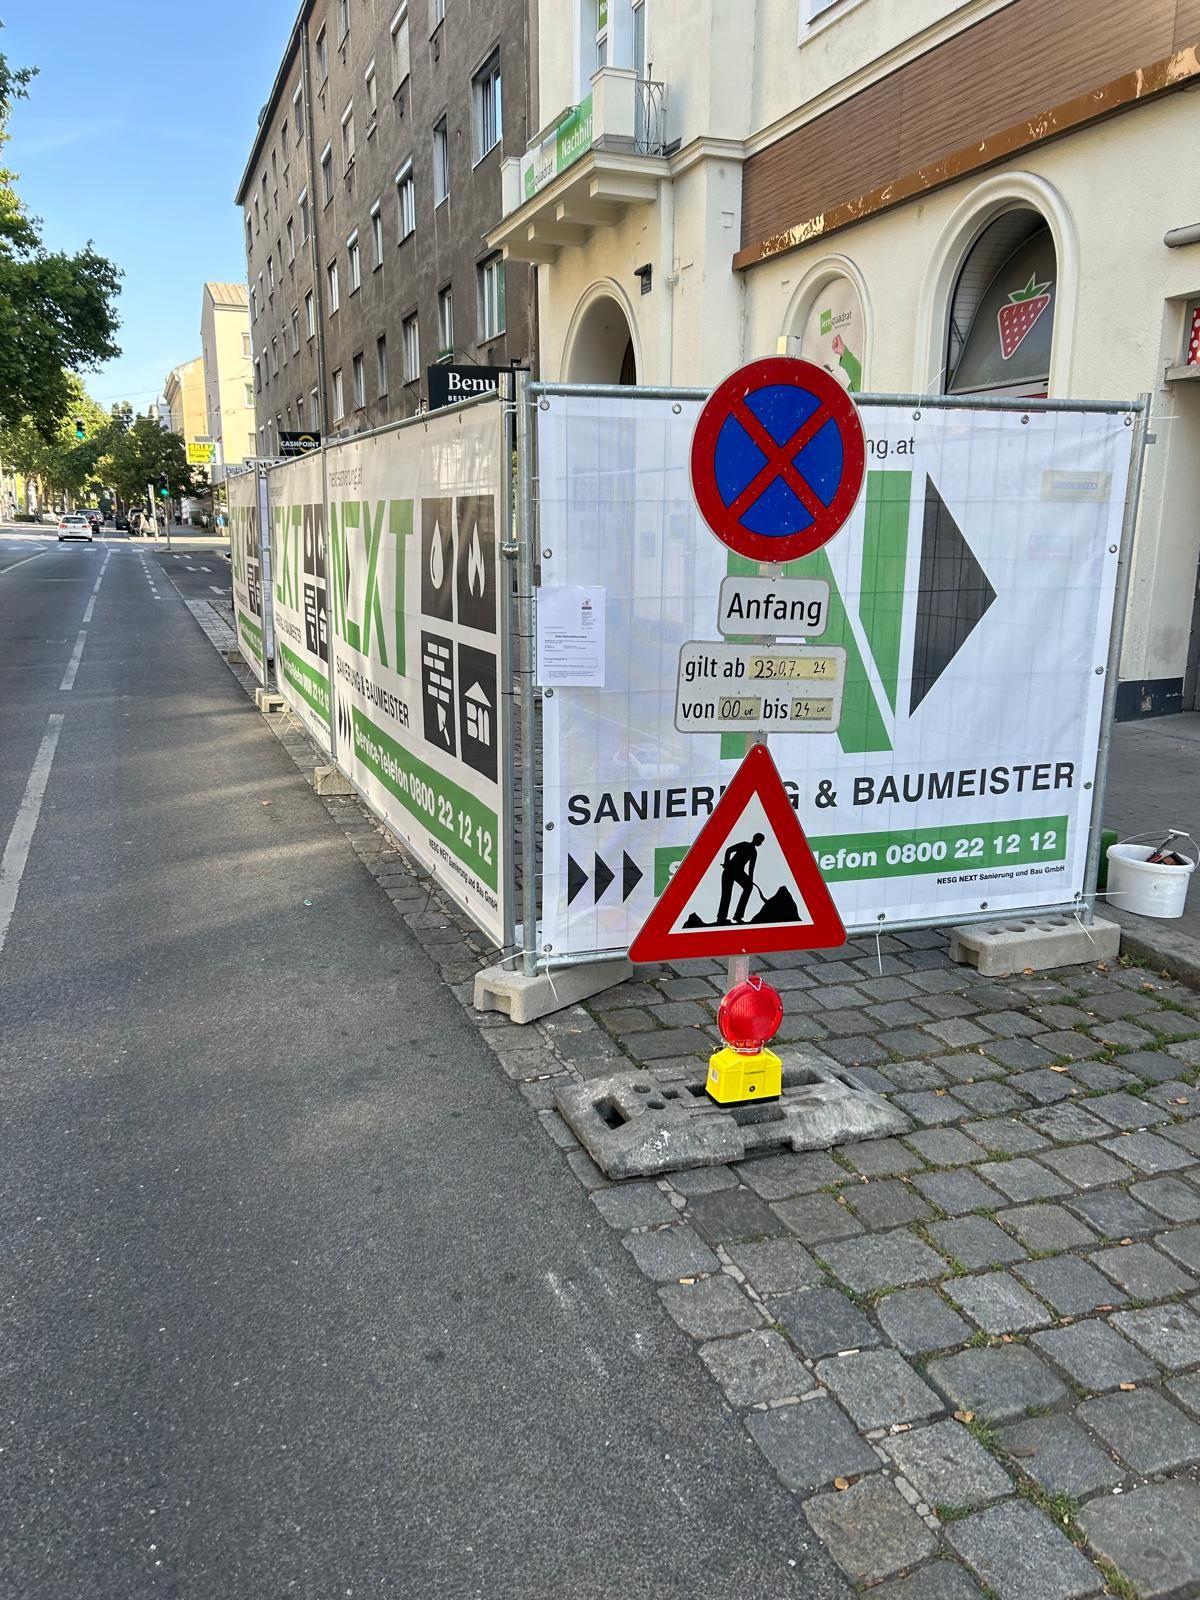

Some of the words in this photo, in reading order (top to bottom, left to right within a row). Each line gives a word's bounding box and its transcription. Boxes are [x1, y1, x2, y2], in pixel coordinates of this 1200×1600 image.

[447, 372, 496, 391] Benu
[280, 440, 320, 448] CASHPOINT
[866, 436, 916, 459] ng.at
[726, 592, 822, 627] Anfang
[685, 655, 718, 682] gilt
[723, 657, 745, 678] ab
[366, 678, 410, 729] BAUMEISTER
[682, 702, 715, 719] von
[721, 700, 741, 718] 00
[763, 697, 789, 719] bis
[795, 702, 810, 718] 24
[355, 722, 409, 793] Service-Telefon
[410, 772, 435, 817] 0800
[438, 794, 454, 832] 22
[458, 810, 472, 848] 12
[476, 826, 492, 866] 12
[814, 779, 838, 809] &
[852, 761, 1075, 807] BAUMEISTER
[886, 840, 947, 866] 0800
[954, 837, 985, 860] 22
[993, 833, 1021, 855] 12
[1030, 830, 1057, 851] 12
[937, 876, 957, 885] NESG
[958, 874, 978, 883] NEXT
[979, 871, 1014, 881] Sanierung
[1015, 868, 1029, 877] und
[1044, 865, 1065, 873] GmbH
